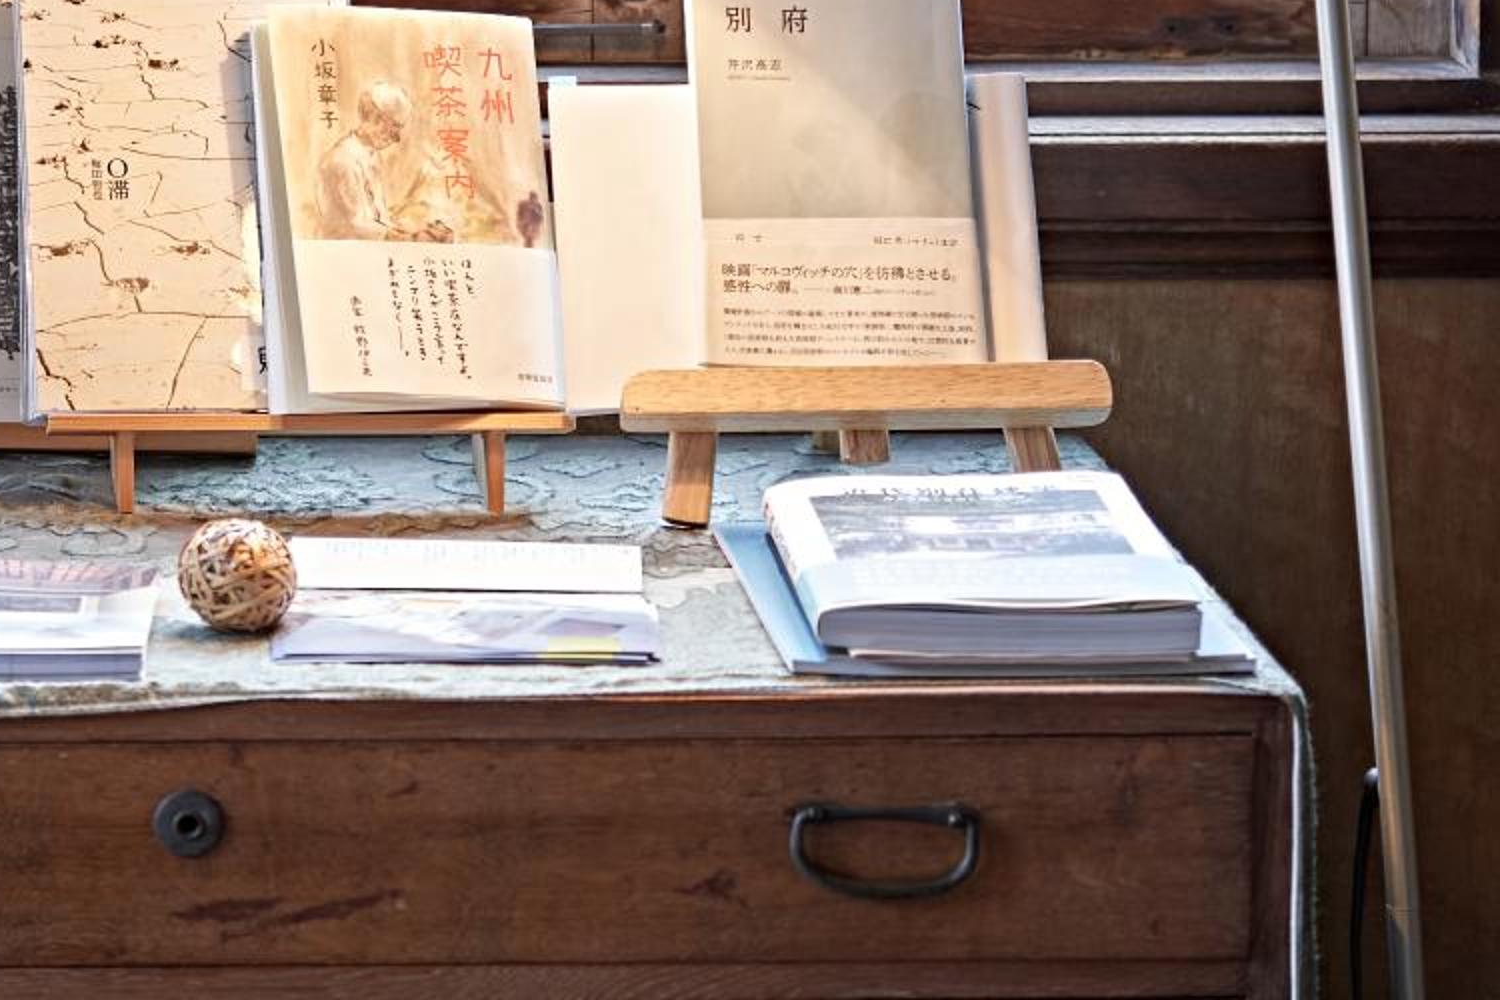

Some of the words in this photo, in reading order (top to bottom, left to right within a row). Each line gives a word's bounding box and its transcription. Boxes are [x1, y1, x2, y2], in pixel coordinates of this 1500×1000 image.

[724, 7, 808, 34] 別府
[310, 39, 340, 130] 小坂章子
[422, 45, 476, 201] 喫茶案内
[478, 46, 515, 125] 九州
